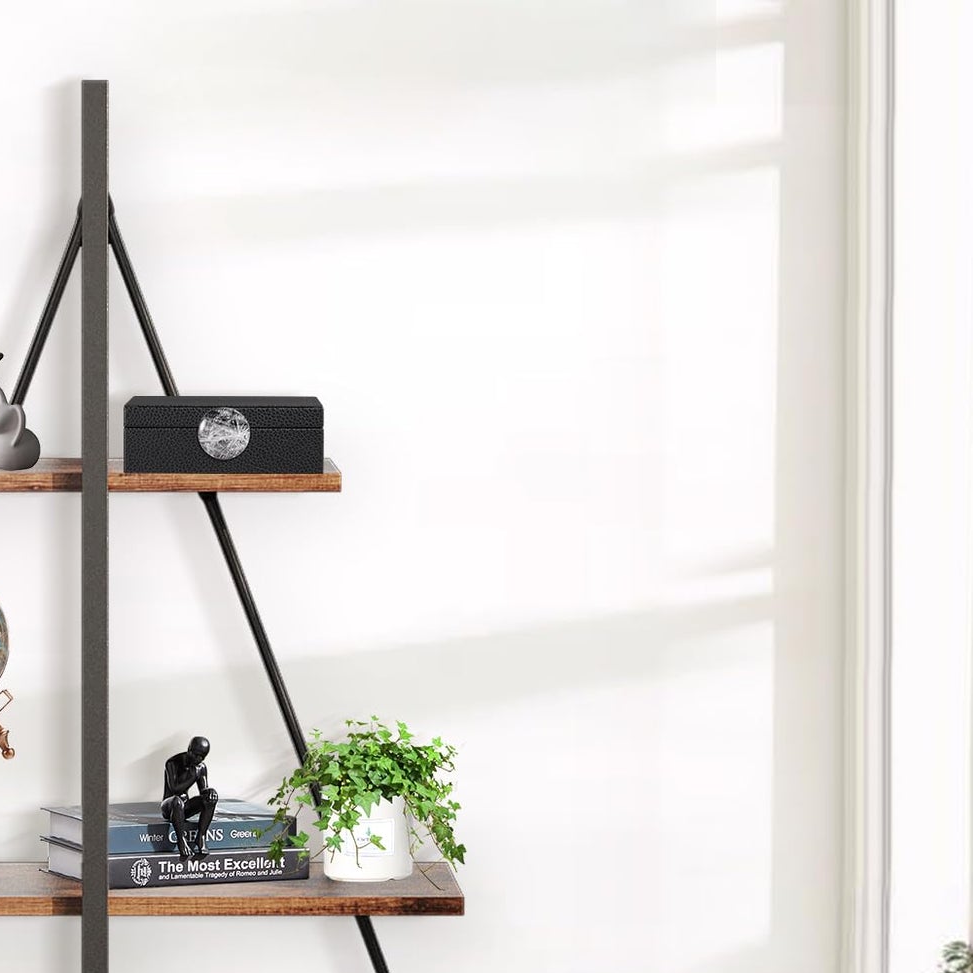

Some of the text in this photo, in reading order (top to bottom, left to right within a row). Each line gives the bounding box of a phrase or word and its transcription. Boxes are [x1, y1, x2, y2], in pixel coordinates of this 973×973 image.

[139, 833, 164, 842] Winter
[158, 861, 184, 873] The
[188, 860, 220, 872] Most
[170, 872, 204, 880] Lamentable
[205, 870, 228, 878] Tragedy
